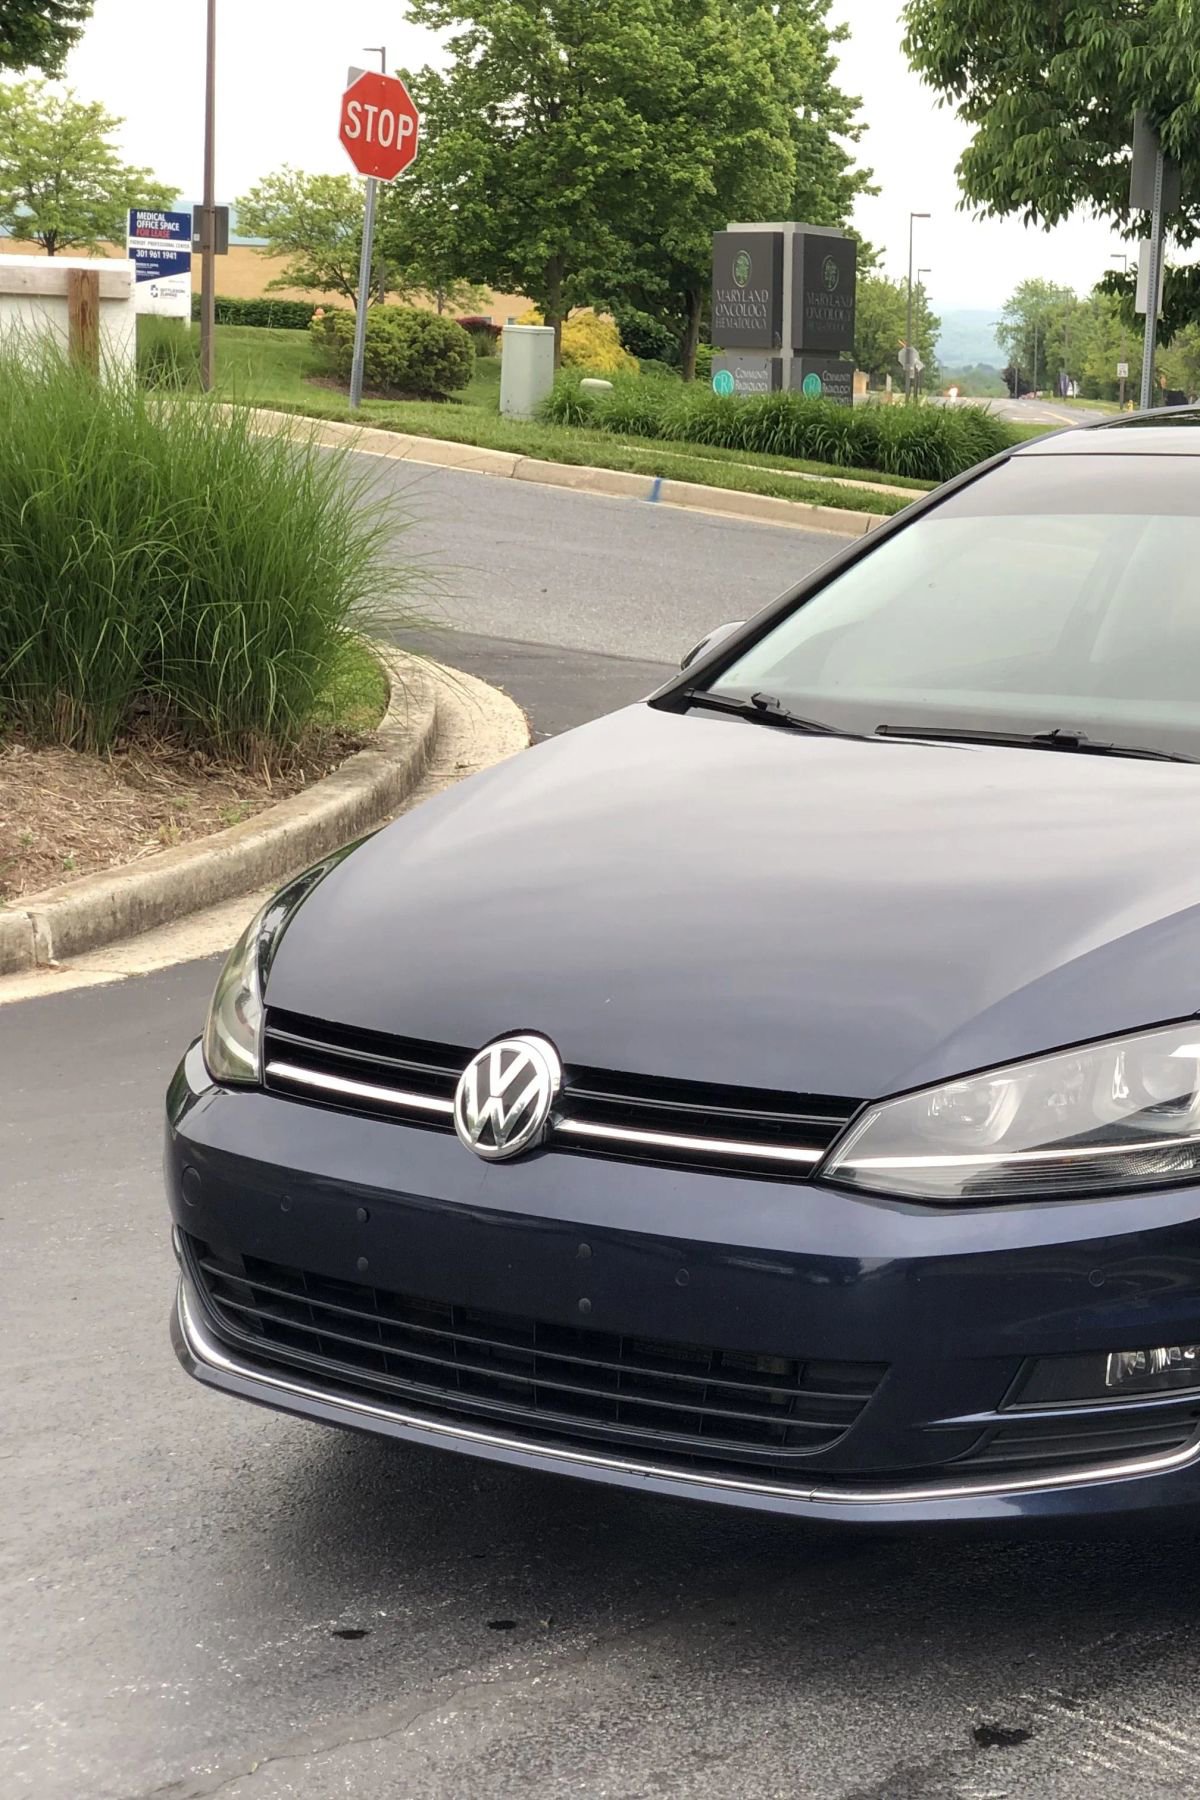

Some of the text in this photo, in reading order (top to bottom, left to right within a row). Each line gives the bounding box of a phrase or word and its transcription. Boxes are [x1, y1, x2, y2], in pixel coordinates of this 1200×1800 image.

[344, 100, 414, 151] STOP
[136, 211, 166, 222] MEDICAL
[136, 220, 180, 232] OFFICE SPACE
[136, 228, 171, 239] FOR LEASE
[136, 250, 177, 260] 301 961 1941
[716, 289, 769, 304] MARYLAND
[806, 292, 853, 308] MARYLAND
[715, 303, 768, 318] ONCOLOGY
[806, 306, 852, 322] ONCOLOGY
[715, 317, 768, 329] HEMATOLOGY
